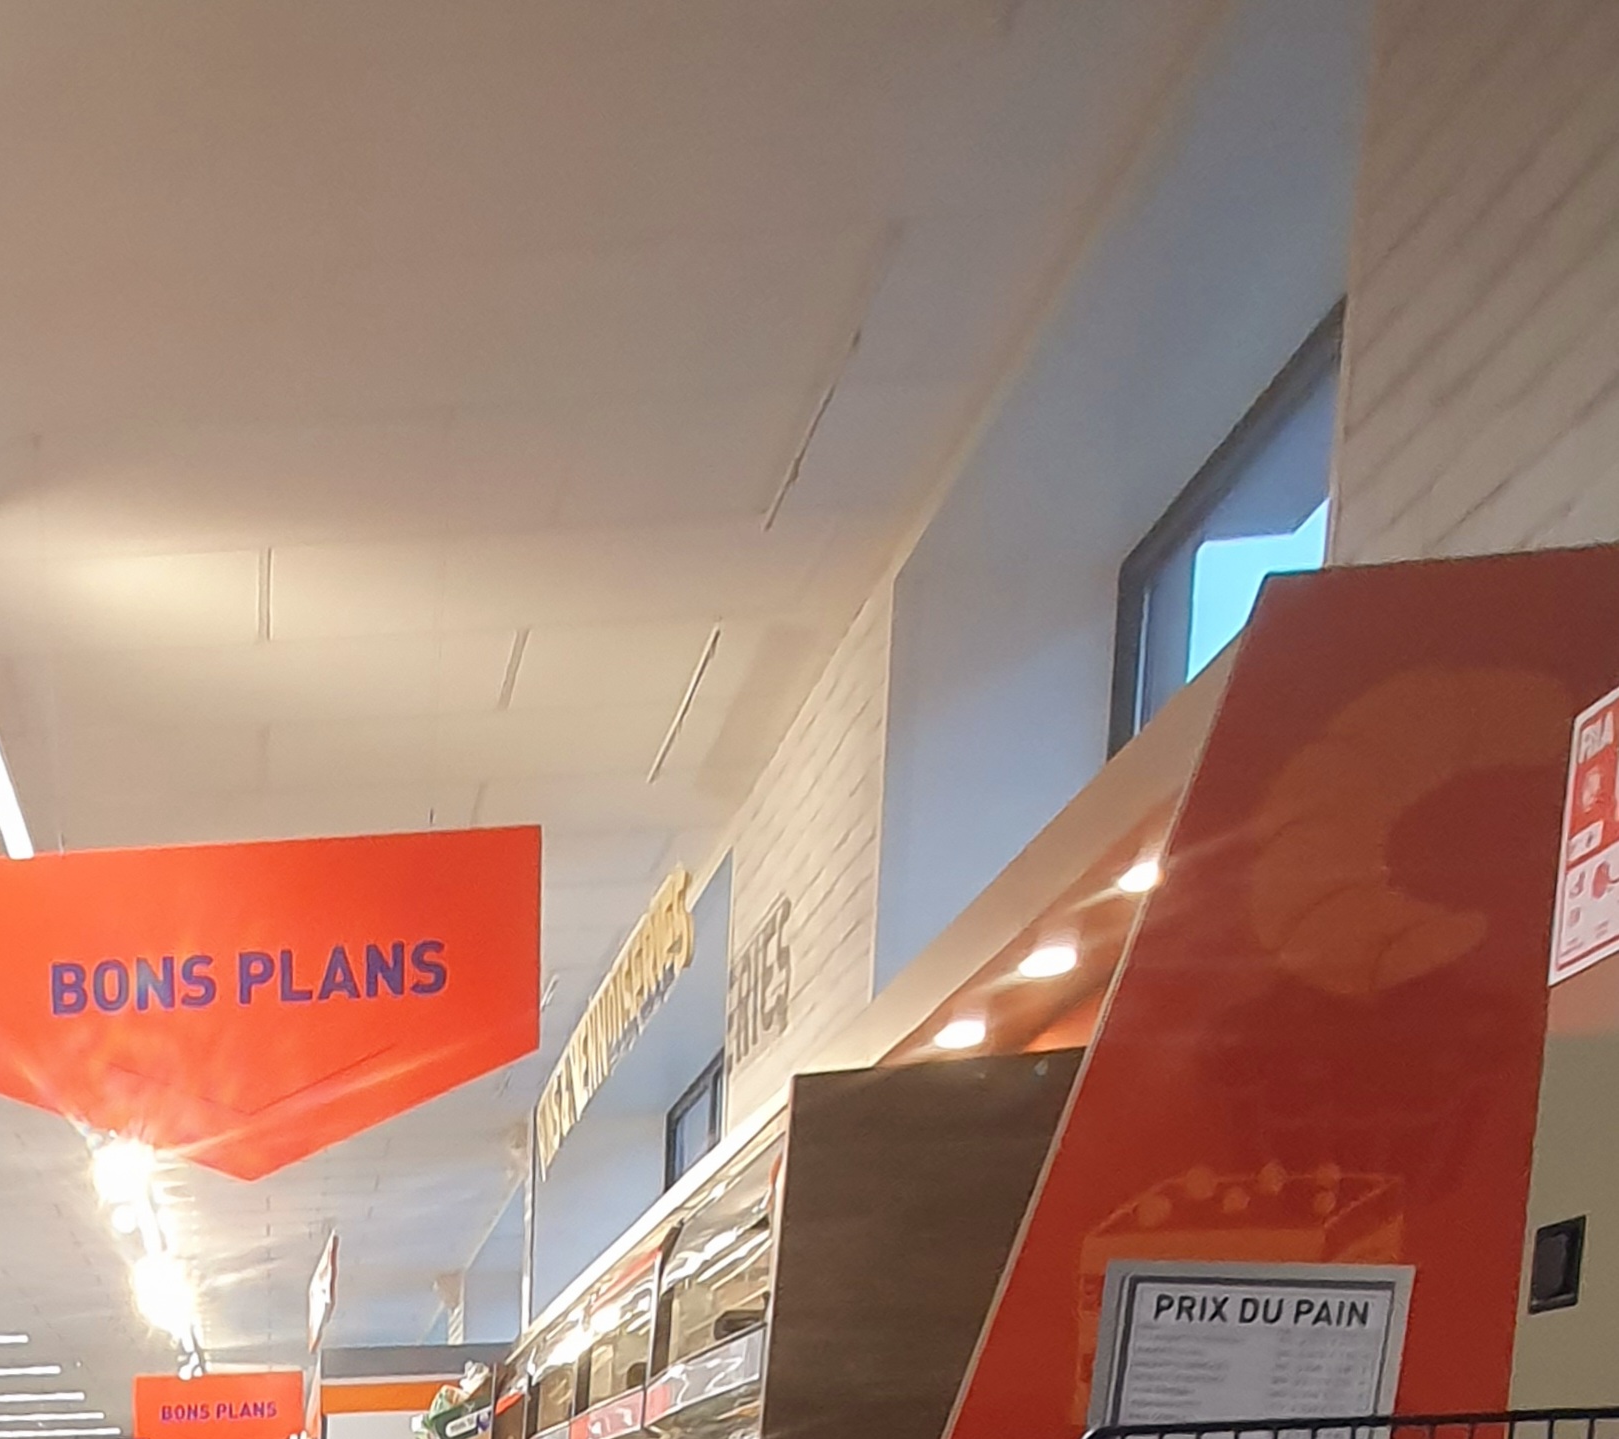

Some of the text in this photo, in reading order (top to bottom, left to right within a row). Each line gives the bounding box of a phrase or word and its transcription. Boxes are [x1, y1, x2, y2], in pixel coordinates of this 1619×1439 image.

[50, 940, 446, 1016] BONS PLANS
[1153, 1293, 1369, 1328] PRIX DU PAIN
[161, 1401, 277, 1421] BONS PLANS
